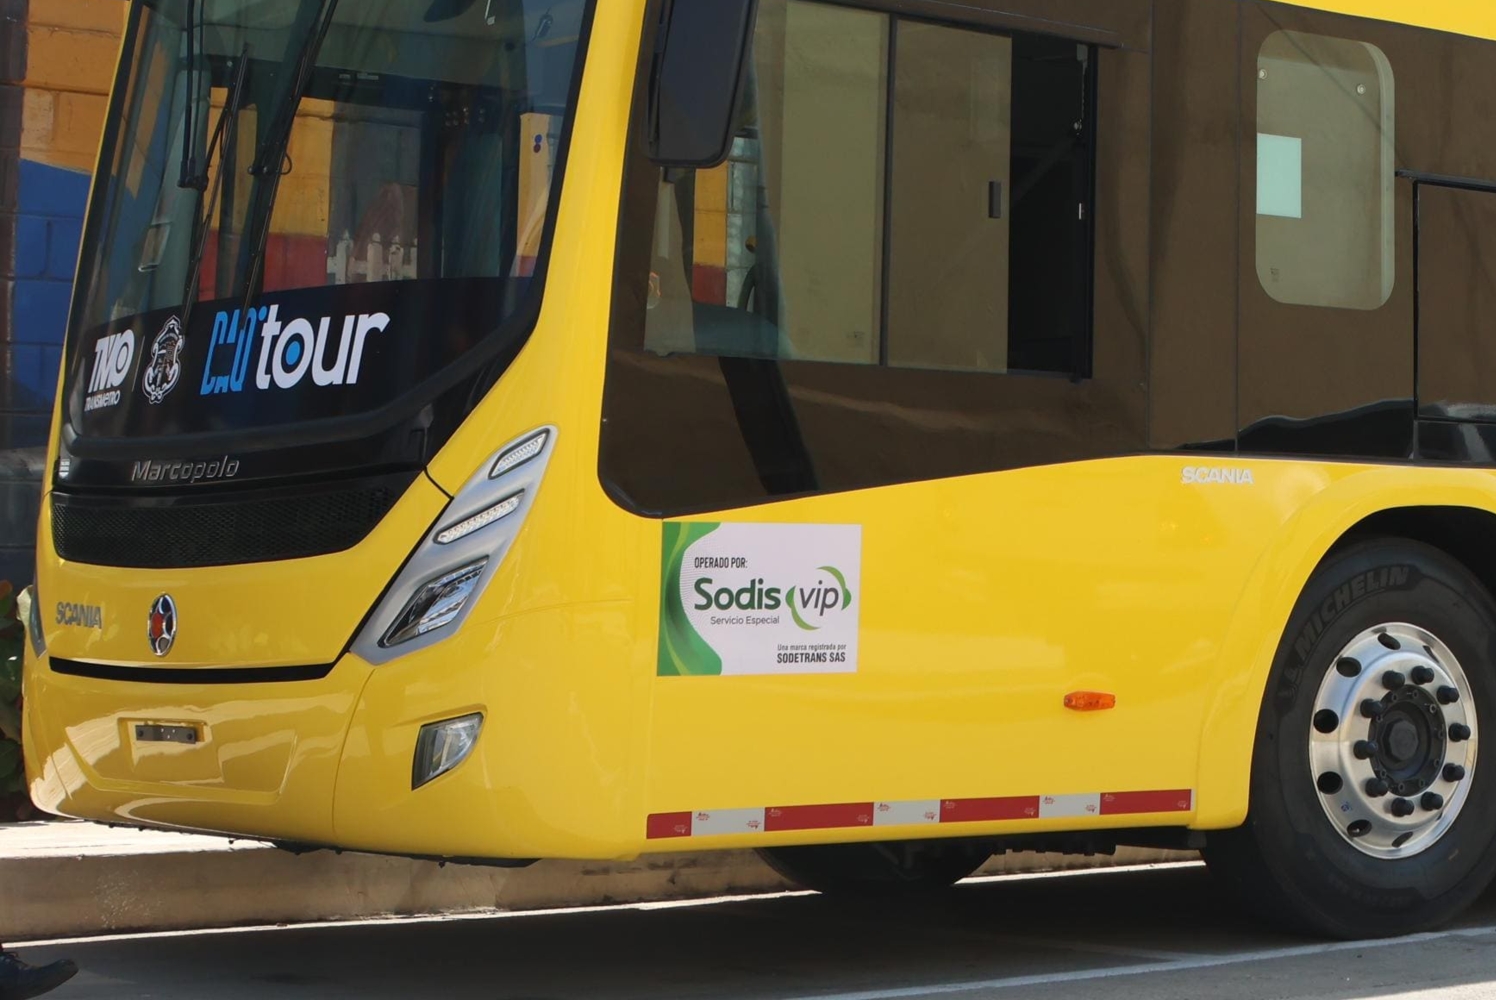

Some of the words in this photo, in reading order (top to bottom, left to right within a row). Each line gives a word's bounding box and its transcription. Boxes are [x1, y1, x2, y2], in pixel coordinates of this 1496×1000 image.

[88, 329, 135, 393] TMO
[131, 455, 240, 484] Marcopolo
[1180, 466, 1254, 484] SCANIA
[694, 557, 729, 569] OPERADO
[731, 557, 748, 569] POR:
[694, 577, 781, 611] Sodis
[799, 580, 839, 616] vip
[56, 602, 103, 629] SCANIA
[710, 616, 744, 625] Servicio
[746, 616, 780, 626] Especial
[1296, 564, 1410, 660] MICHELIN
[777, 652, 827, 664] SODETRANS
[829, 652, 846, 663] SAS
[808, 643, 836, 652] registrada
[837, 644, 846, 652] por
